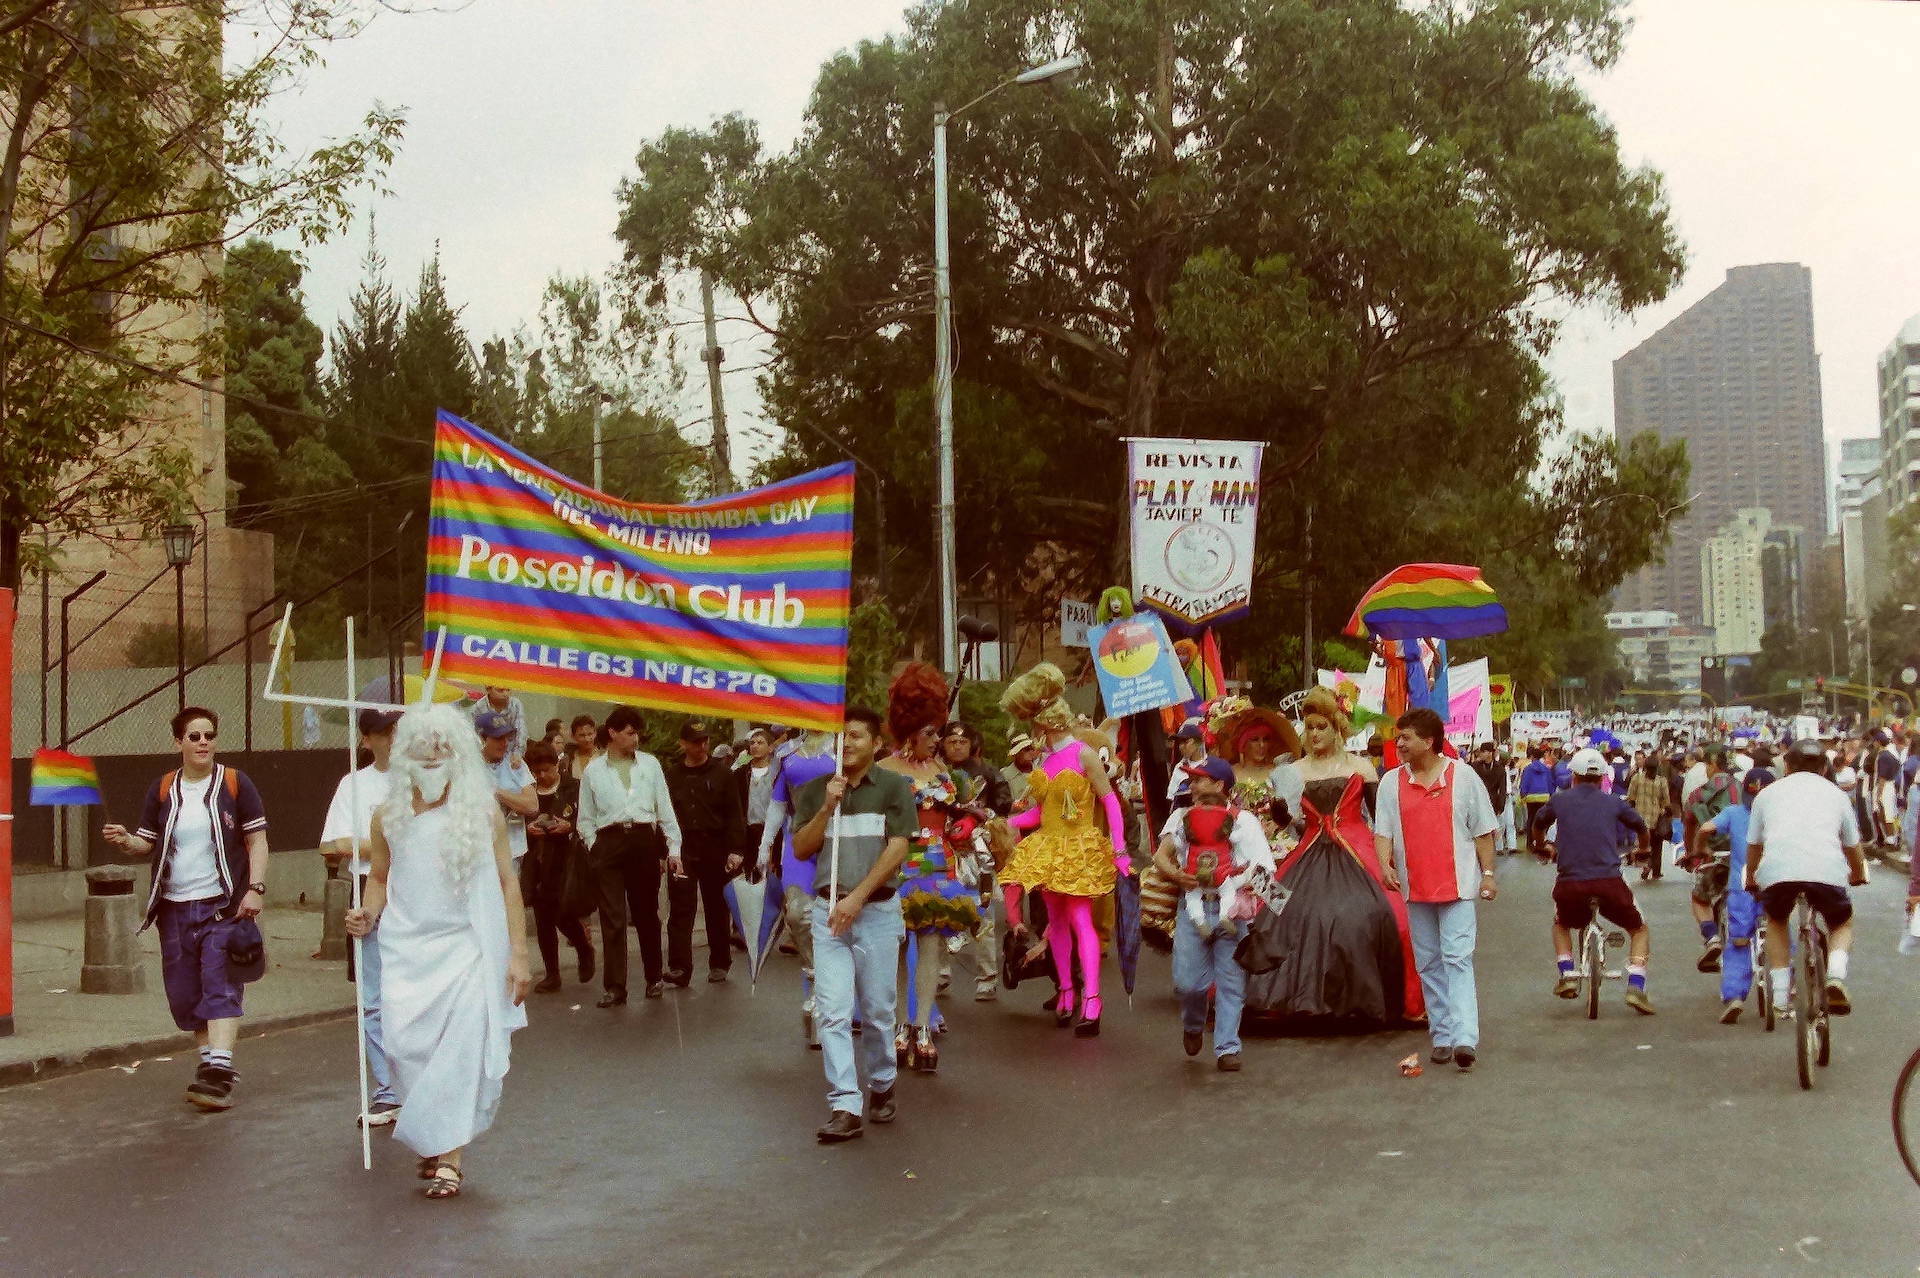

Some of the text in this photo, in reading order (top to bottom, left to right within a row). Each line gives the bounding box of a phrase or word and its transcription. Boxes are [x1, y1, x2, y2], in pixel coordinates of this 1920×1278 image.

[1145, 453, 1243, 469] REVISTA
[461, 442, 494, 473] LA
[667, 508, 761, 530] RUMBA
[769, 496, 818, 525] GAY
[1132, 479, 1258, 507] PLAY MAN
[552, 499, 712, 556] DEL MILENIO
[1145, 507, 1243, 524] JAVIER TE
[455, 534, 805, 629] Poseidón Club
[461, 634, 580, 672] CALLE
[587, 651, 635, 678] 63
